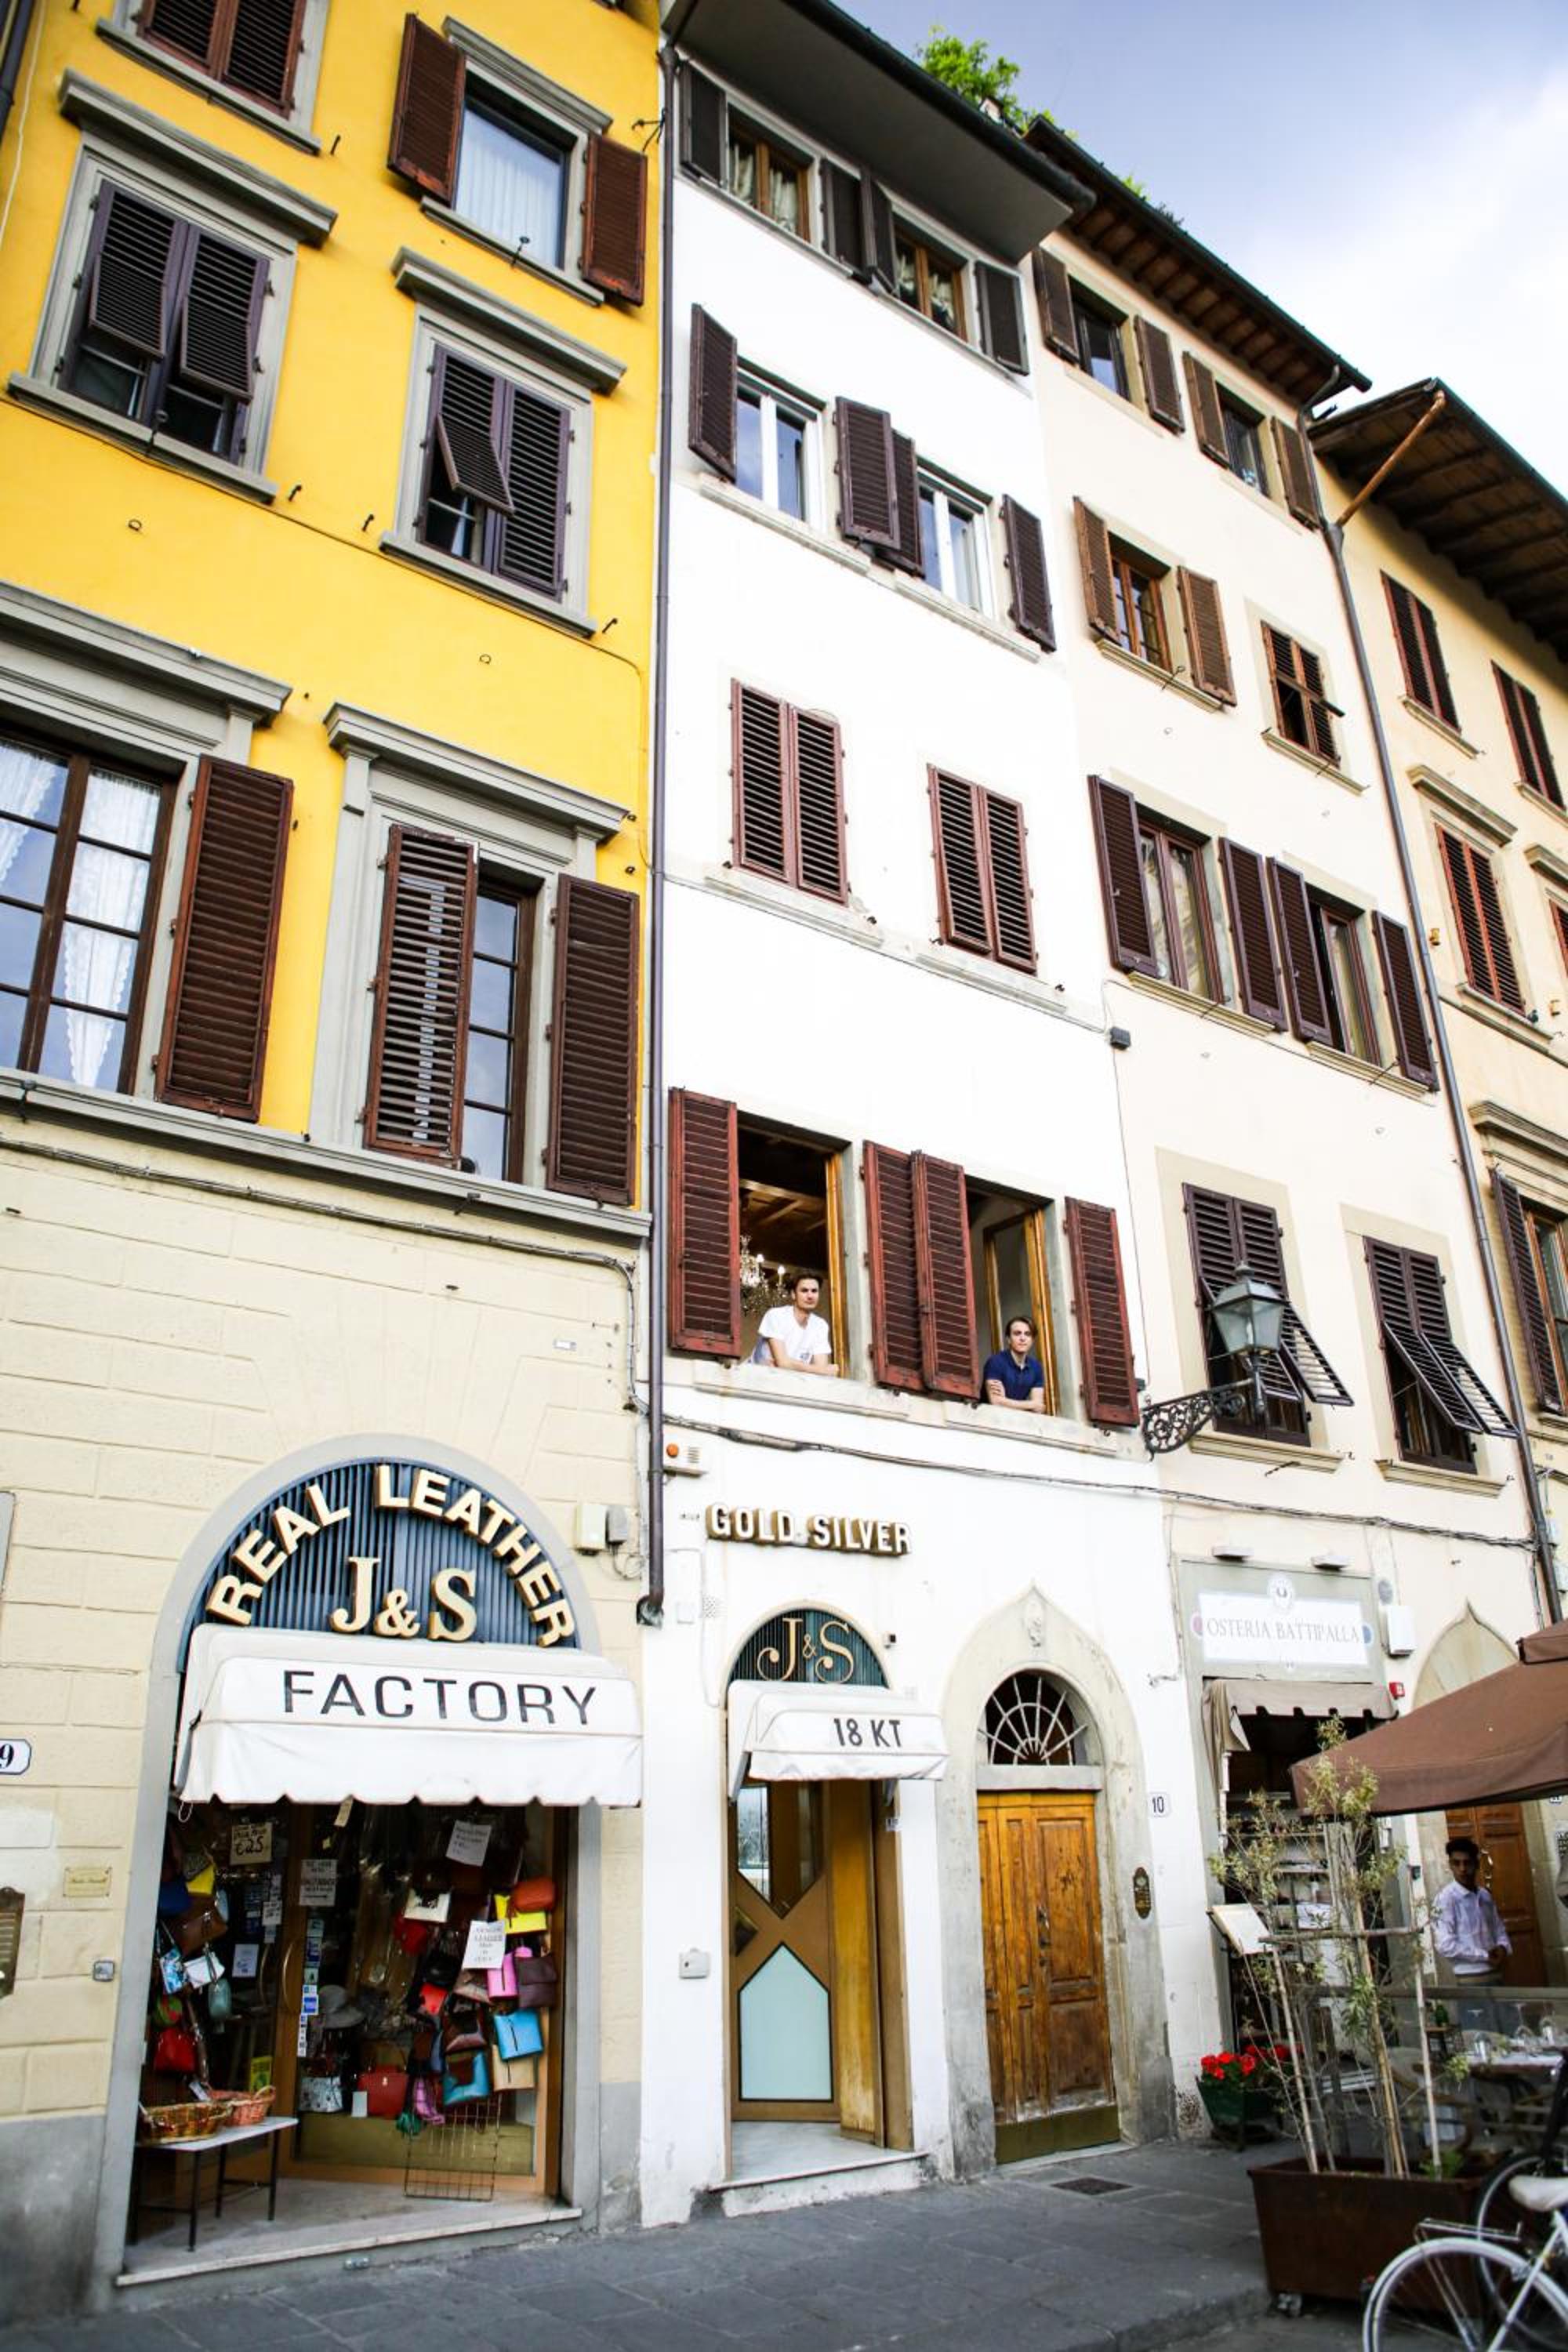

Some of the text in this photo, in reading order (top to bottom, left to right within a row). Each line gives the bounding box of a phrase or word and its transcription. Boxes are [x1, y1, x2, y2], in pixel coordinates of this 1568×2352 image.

[206, 1464, 576, 1648] REAL LEATHER
[706, 1502, 912, 1556] GOLD SILVER
[328, 1555, 479, 1642] J&S
[757, 1617, 855, 1684] J&S
[1206, 1617, 1273, 1641] OSTERIA
[283, 1669, 597, 1726] FACTORY
[833, 1718, 902, 1748] 18 KT
[1152, 1795, 1165, 1813] 10
